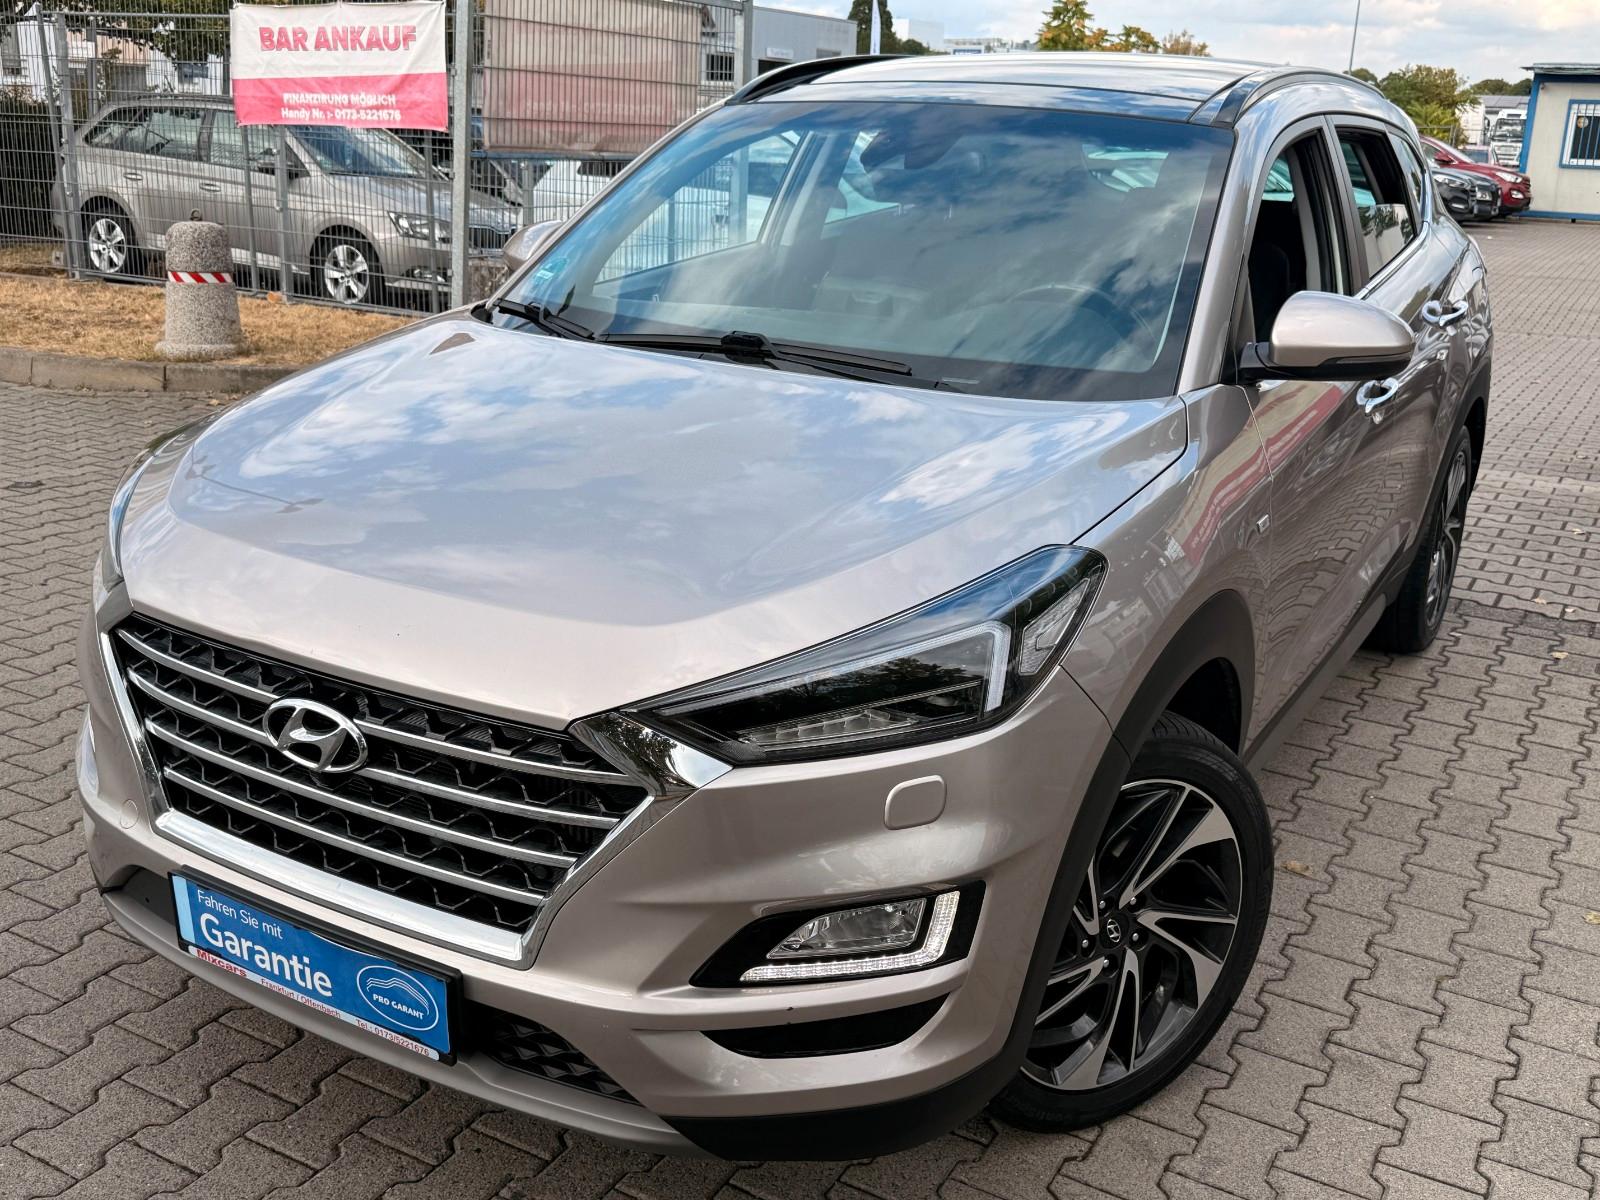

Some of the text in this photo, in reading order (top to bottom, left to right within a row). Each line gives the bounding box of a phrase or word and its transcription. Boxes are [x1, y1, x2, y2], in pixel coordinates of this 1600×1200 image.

[259, 25, 417, 51] BAR ANKAUF
[350, 92, 396, 105] MÖGLICH
[281, 109, 309, 121] Handy
[335, 109, 401, 120] 0173-5221676
[197, 890, 283, 940] Fahren Sie mit
[200, 913, 333, 997] Garantie
[196, 949, 247, 978] Mixcars
[261, 978, 295, 999] Frankfurt
[301, 995, 341, 1019] Offenbach
[374, 1027, 430, 1057] 0173/5221676
[373, 993, 424, 1020] PRO GARANT
